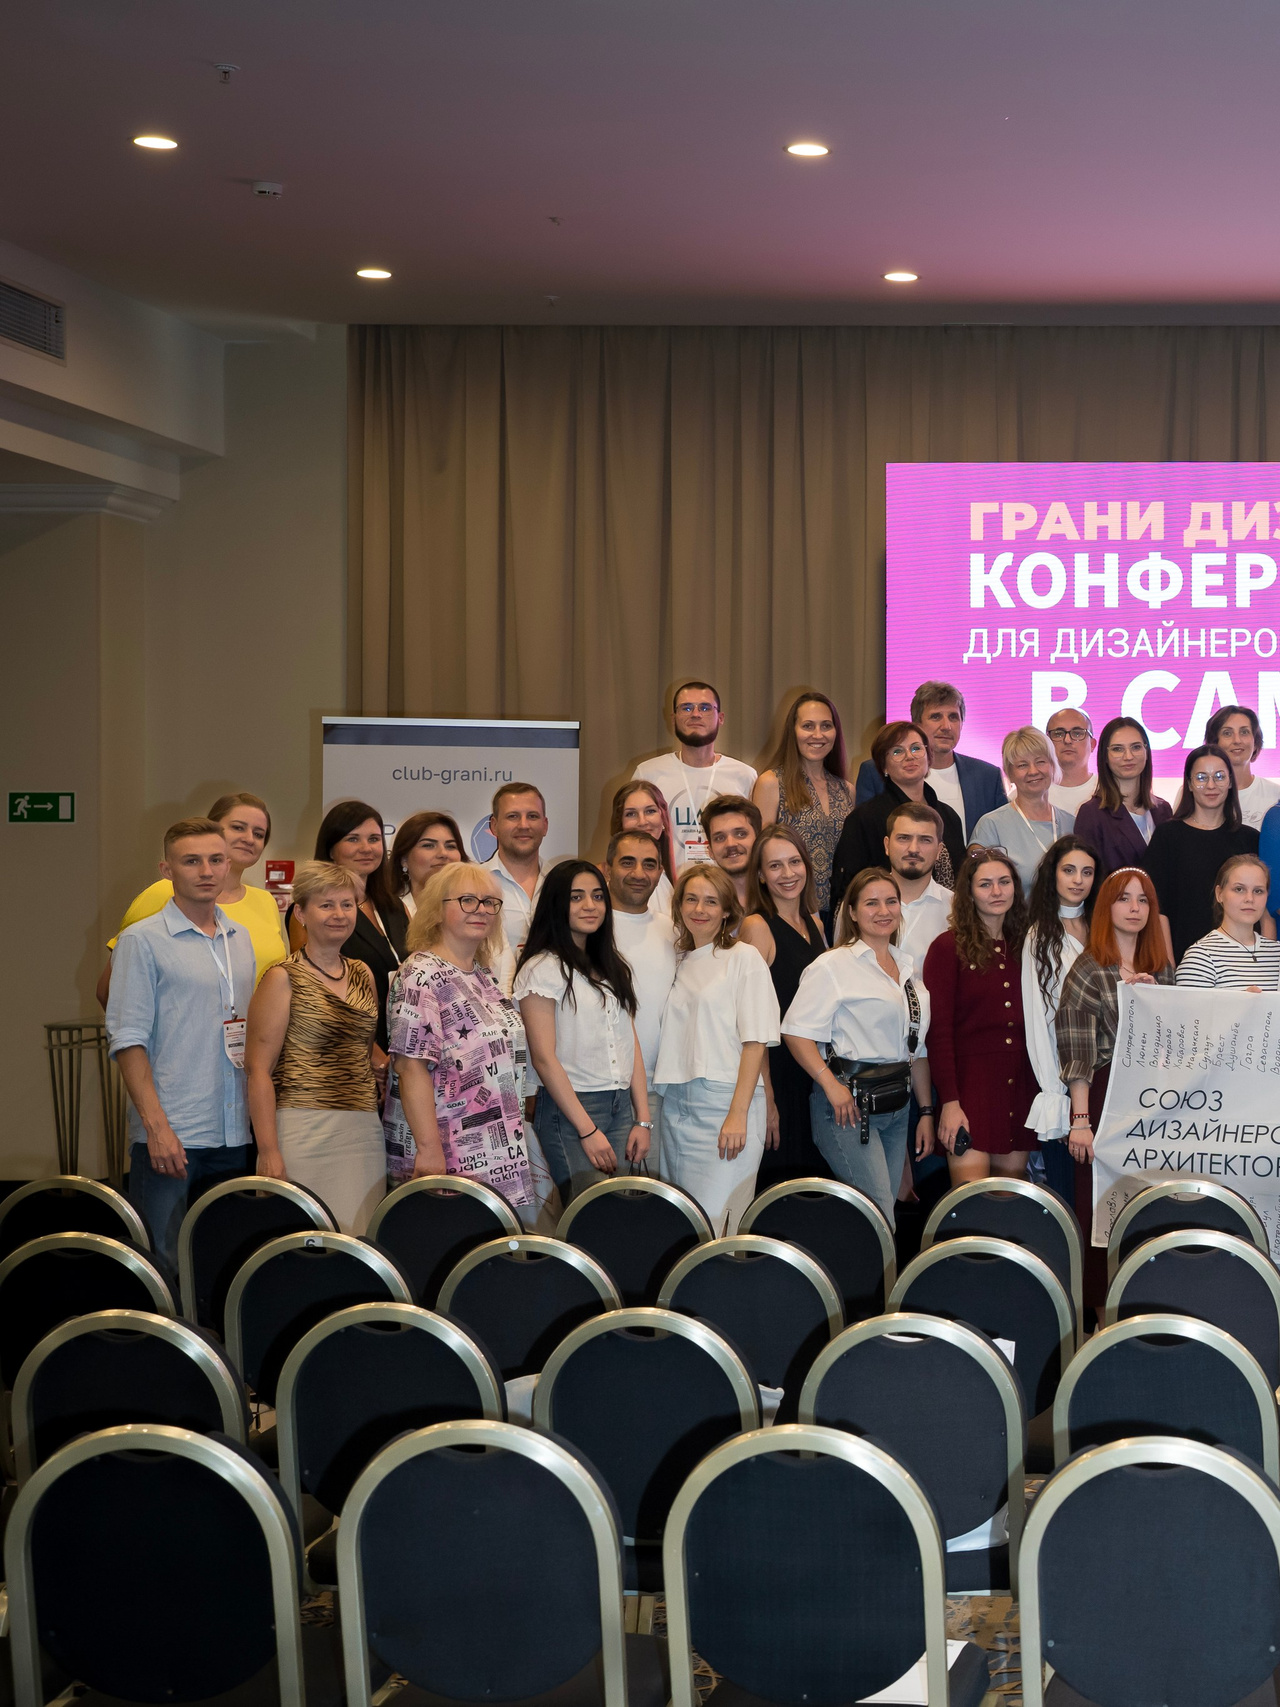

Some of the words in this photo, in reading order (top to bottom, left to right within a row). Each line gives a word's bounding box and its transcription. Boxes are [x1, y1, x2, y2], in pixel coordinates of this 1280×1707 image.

[970, 501, 1165, 541] ГРАНИ
[963, 628, 1040, 664] ДЛЯ
[392, 766, 514, 785] club-grani.ru
[1139, 1088, 1223, 1112] СОЮЗ
